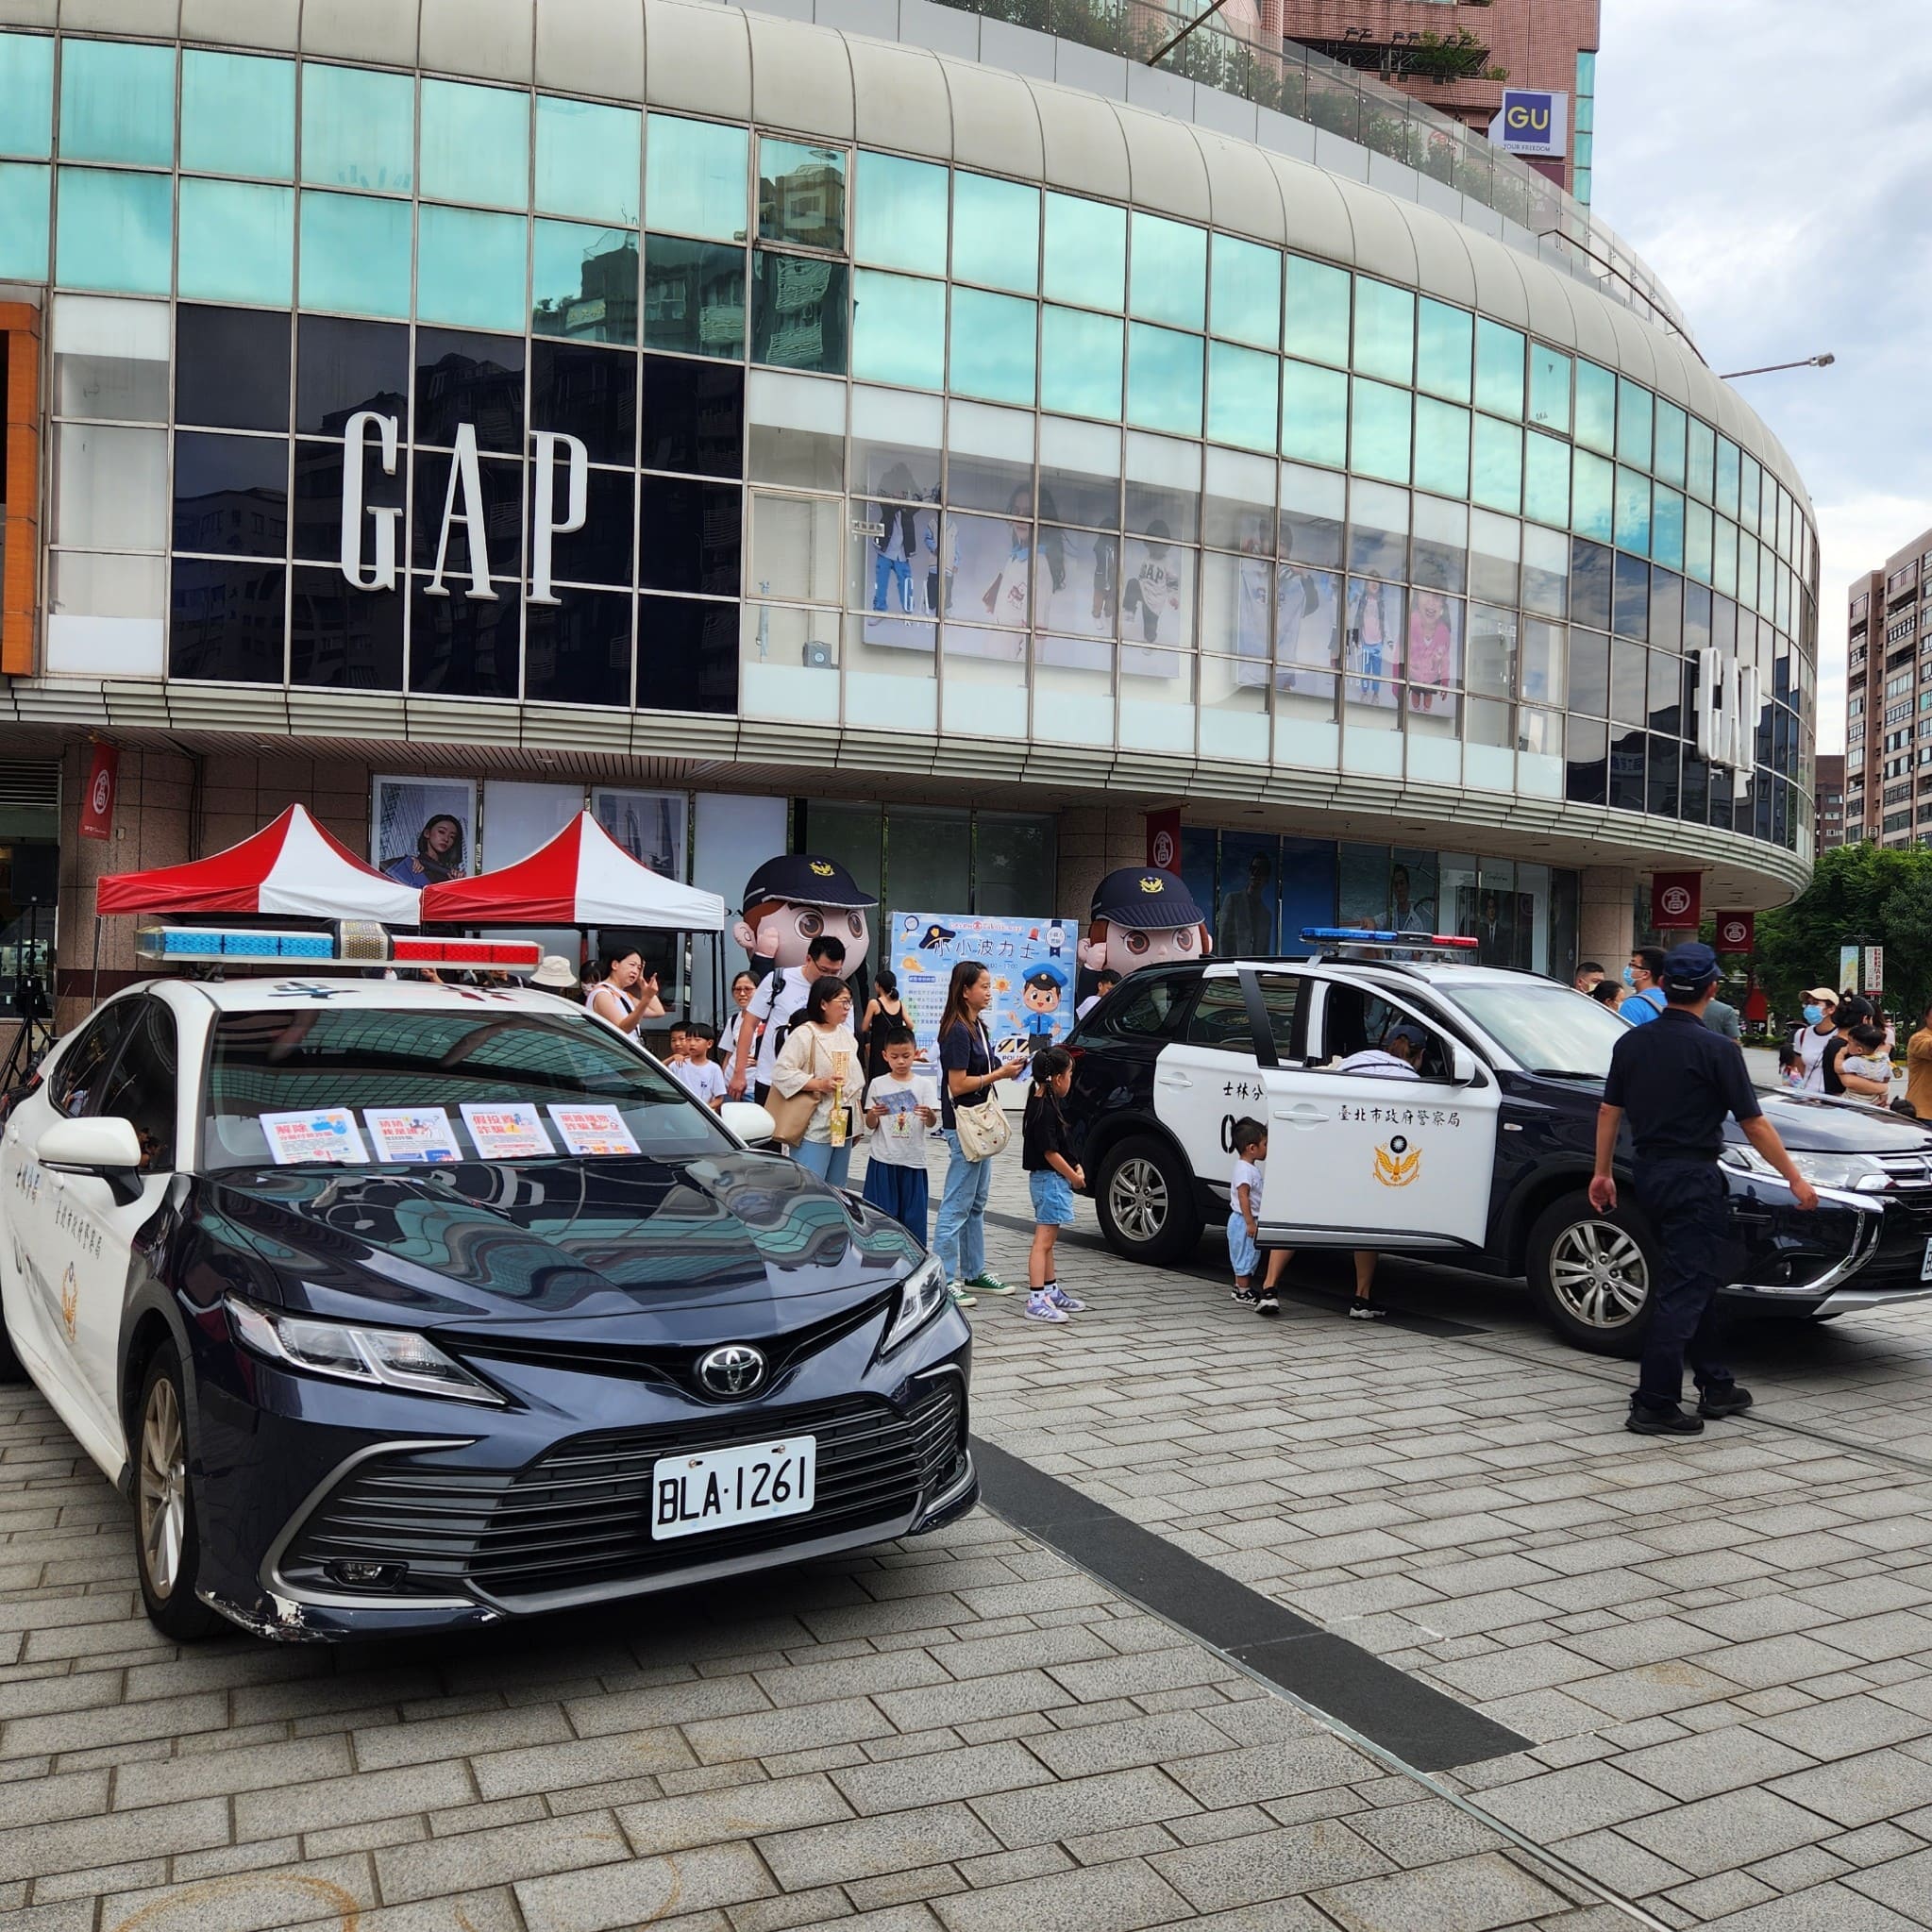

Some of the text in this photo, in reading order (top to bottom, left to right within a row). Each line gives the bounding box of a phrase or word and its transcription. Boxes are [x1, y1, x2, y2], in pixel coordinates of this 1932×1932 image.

[1507, 106, 1549, 130] GU
[341, 411, 588, 605] GAP
[1697, 647, 1762, 772] GAP
[934, 938, 1034, 959] 小小波力士
[1222, 1081, 1268, 1101] 士林分
[1337, 1104, 1461, 1128] 臺北市政府警察局
